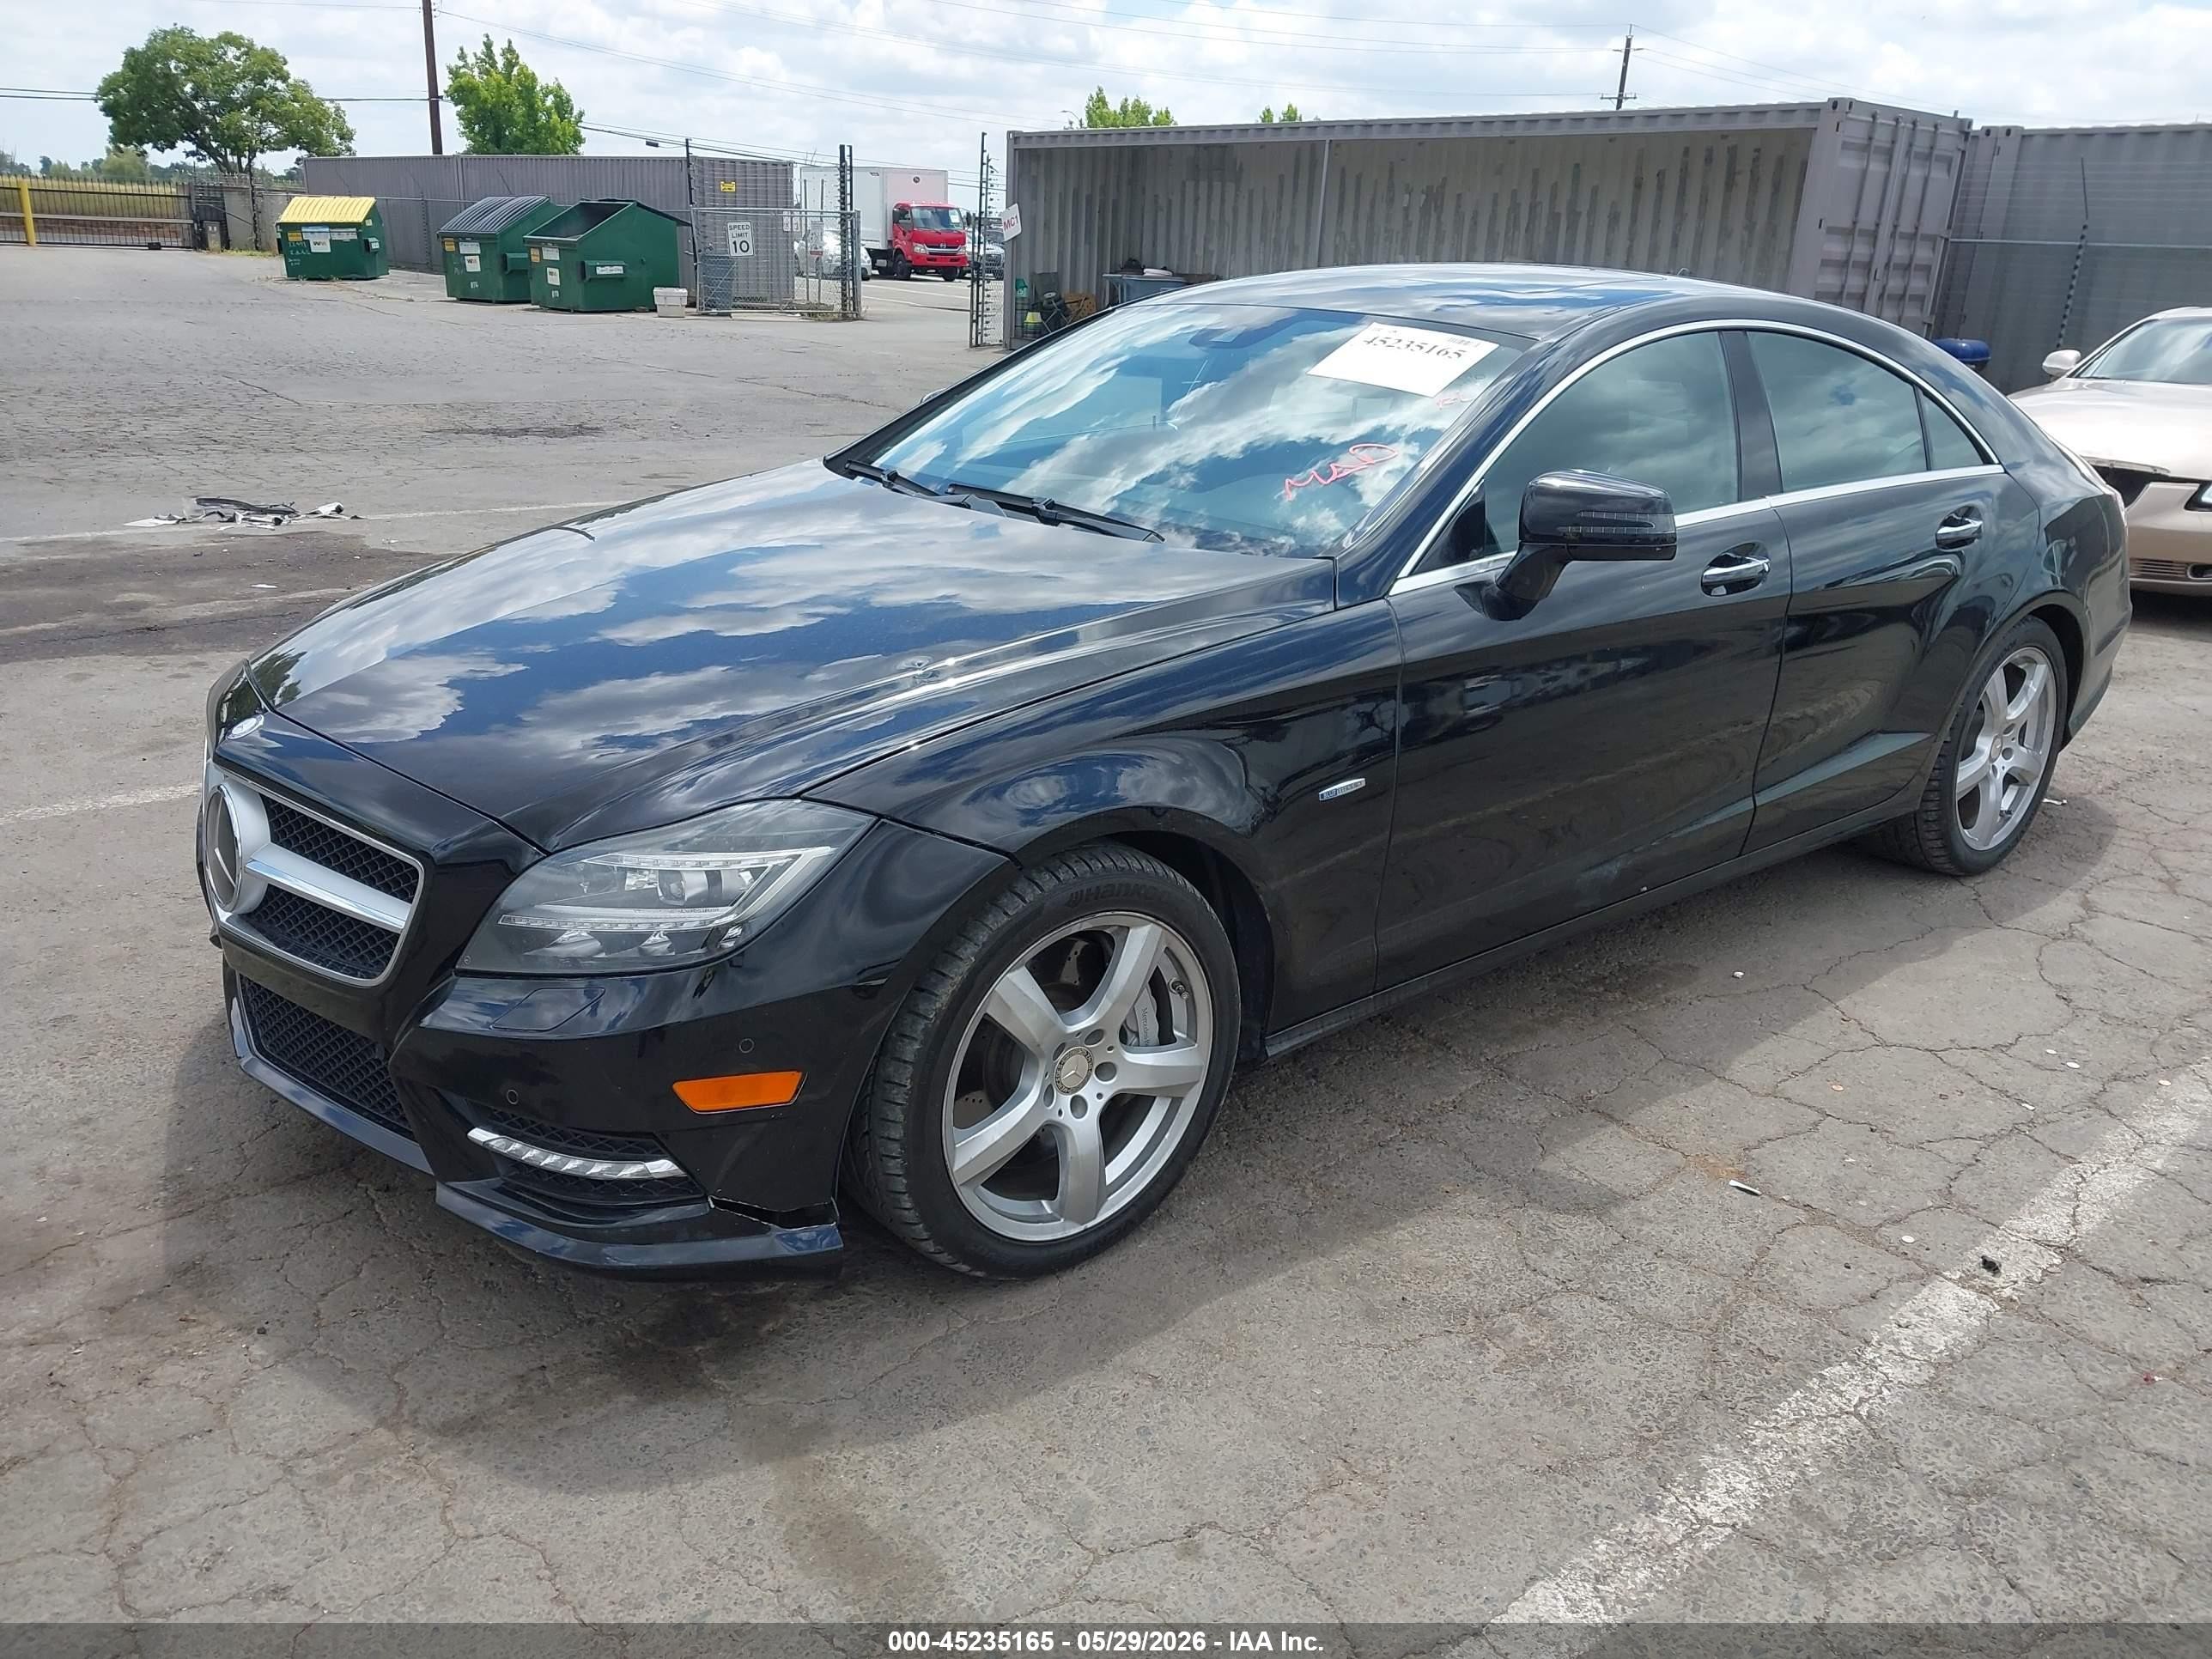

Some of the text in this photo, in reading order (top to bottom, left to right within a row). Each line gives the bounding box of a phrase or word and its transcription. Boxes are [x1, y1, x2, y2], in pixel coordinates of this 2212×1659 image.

[1003, 215, 1018, 231] MC1
[732, 240, 750, 254] 10
[1363, 335, 1468, 359] 45235165
